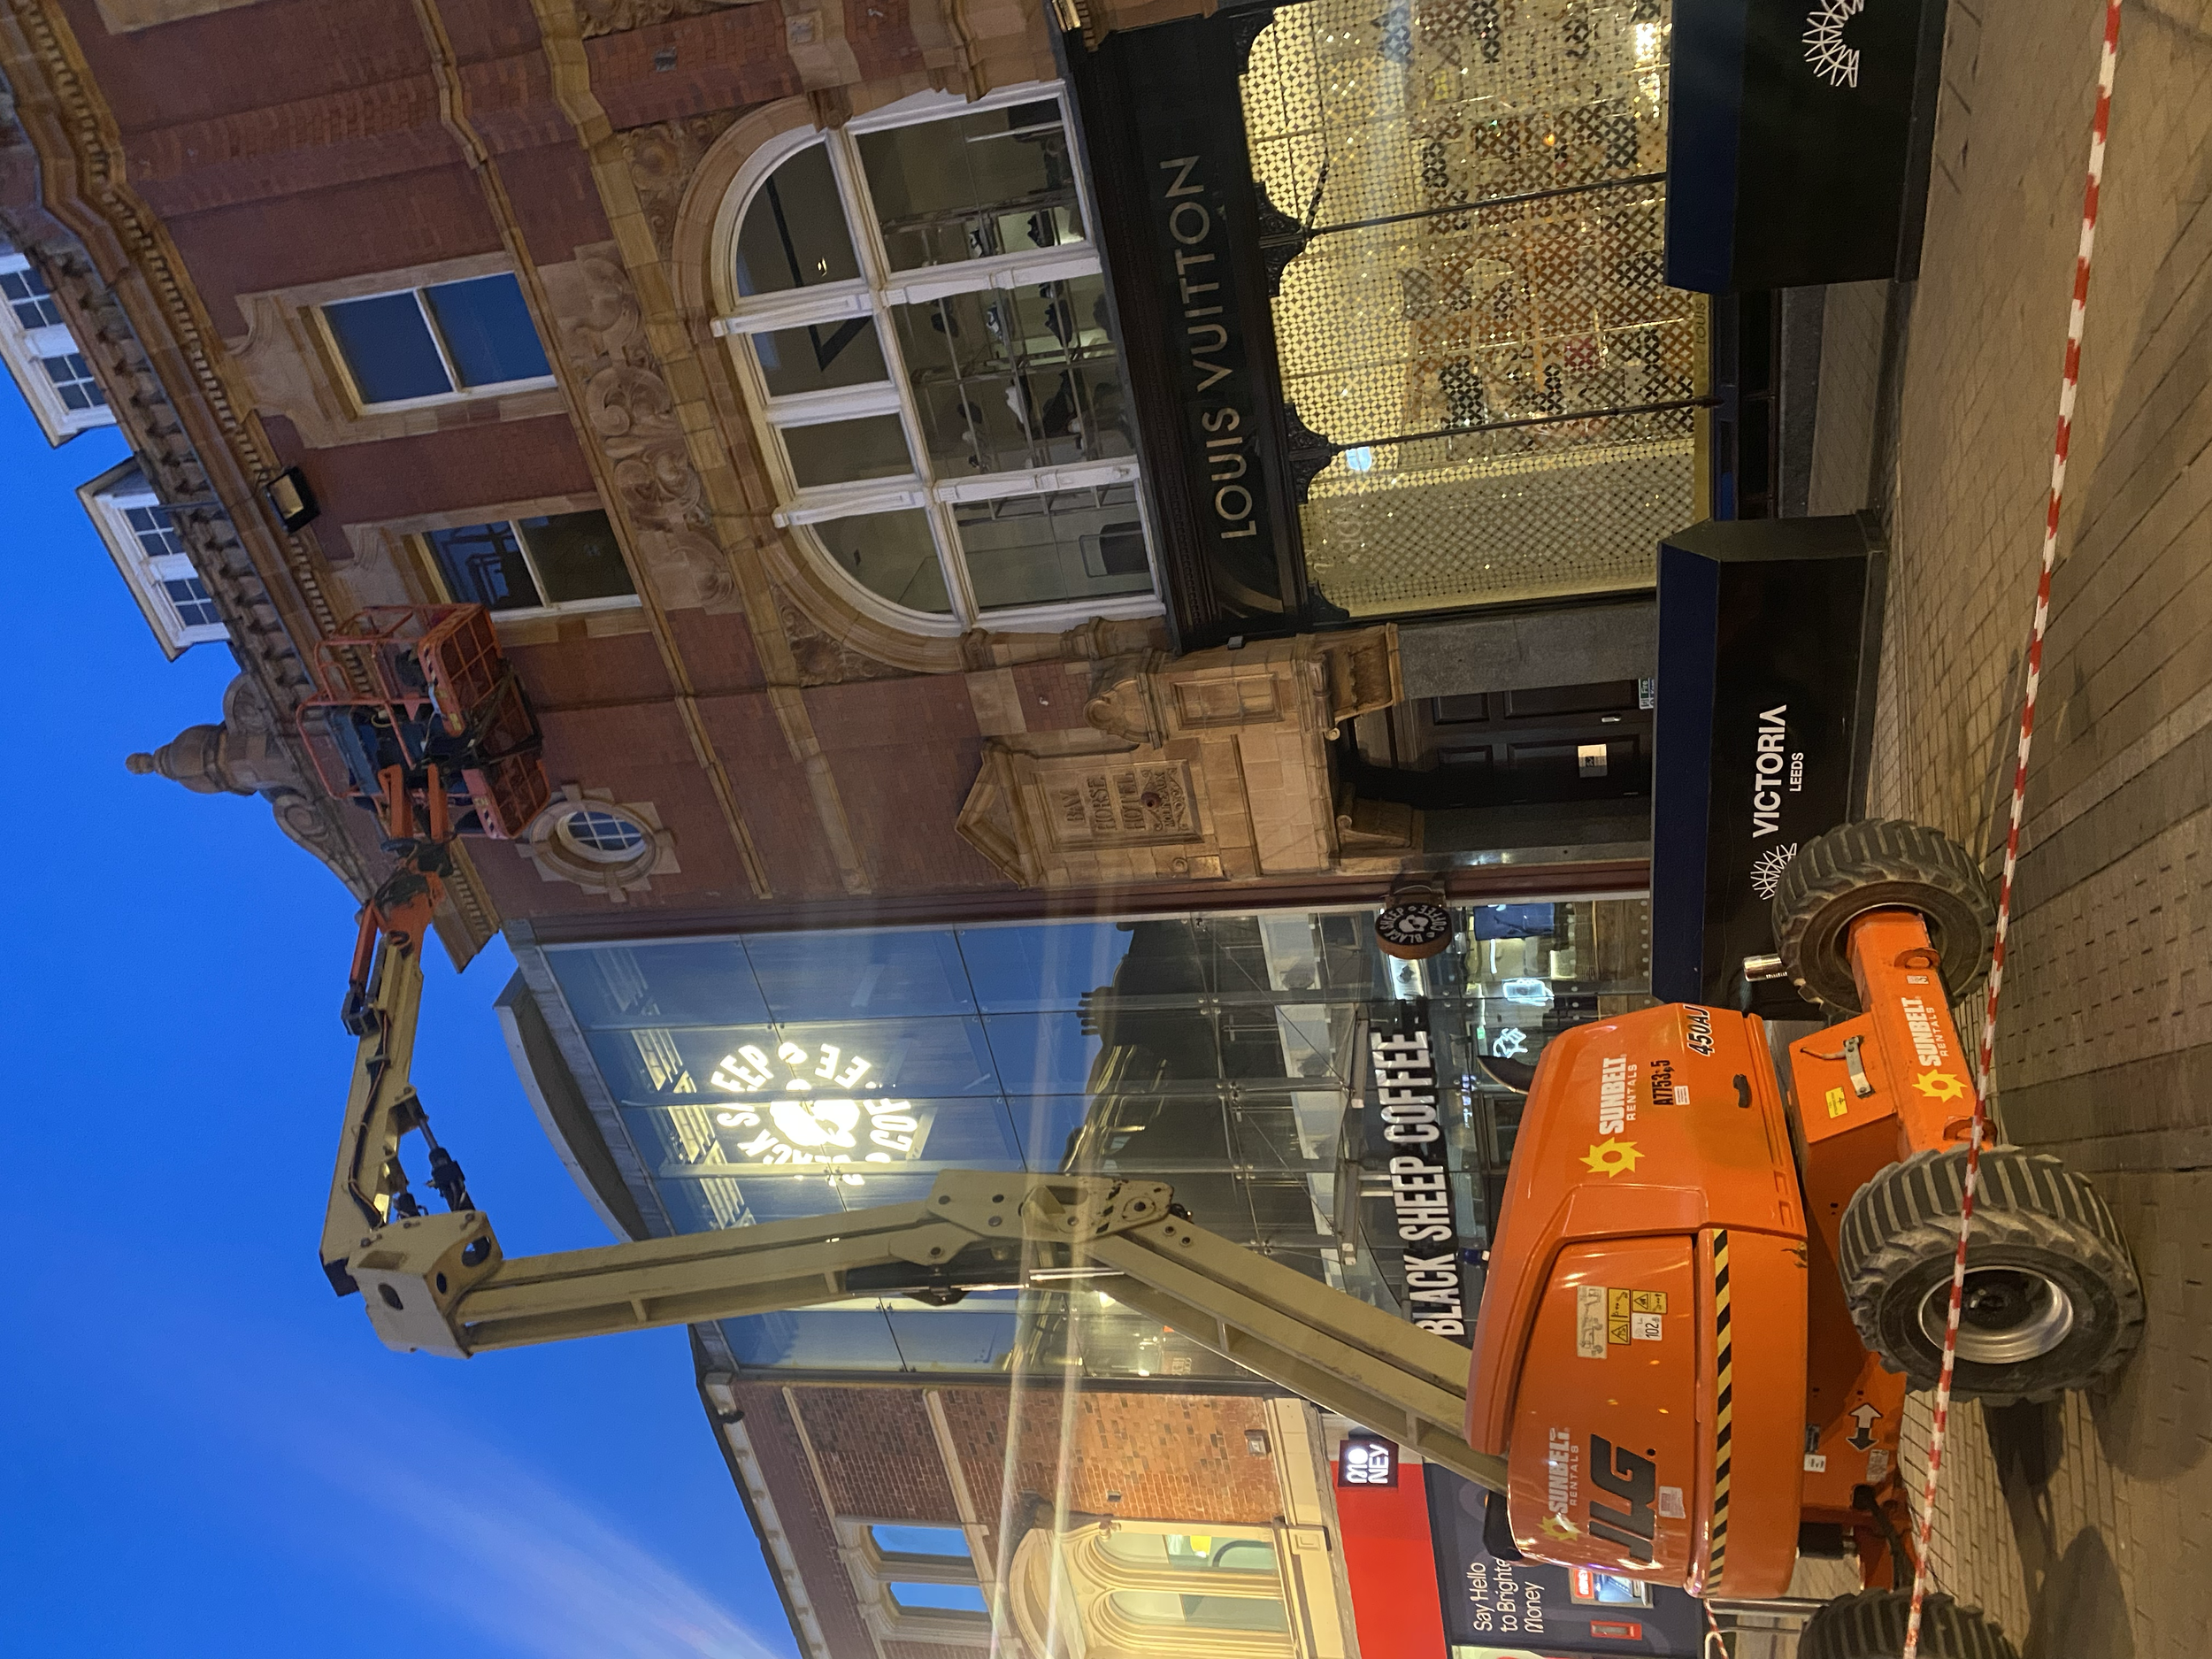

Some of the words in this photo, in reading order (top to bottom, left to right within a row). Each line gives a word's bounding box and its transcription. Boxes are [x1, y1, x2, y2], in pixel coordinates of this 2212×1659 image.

[1160, 156, 1233, 391] VUITTON
[1695, 302, 1707, 344] LOUIS
[1202, 407, 1257, 539] LOUIS
[1753, 704, 1787, 838] VICTORIA
[1789, 752, 1804, 792] LEEDS
[1060, 789, 1086, 822] BAY
[1087, 776, 1118, 831] HORSE
[1118, 772, 1146, 831] HOTEL
[1379, 907, 1404, 930] SHEEP
[1385, 928, 1424, 943] BLACK
[1417, 904, 1448, 932] COFFEE
[1683, 1004, 1716, 1056] 450AJ
[1901, 997, 1942, 1066] SUNBELT
[1925, 1007, 1949, 1056] RENTALS
[1371, 1030, 1440, 1142] COFFEE
[1599, 1057, 1627, 1134] SUNBELT
[1626, 1064, 1637, 1120] RENTALS
[1389, 1156, 1453, 1241] SHEEP
[1402, 1254, 1465, 1335] BLACK
[1645, 1323, 1659, 1338] 102
[1548, 1427, 1570, 1513] SUNBELT
[1570, 1445, 1579, 1506] RENTALS
[1588, 1433, 1656, 1563] JLG
[1466, 1562, 1489, 1601] Hello
[1494, 1559, 1518, 1612] Brighte
[1524, 1581, 1545, 1632] Money
[1472, 1603, 1495, 1631] Say
[1500, 1615, 1518, 1632] to
